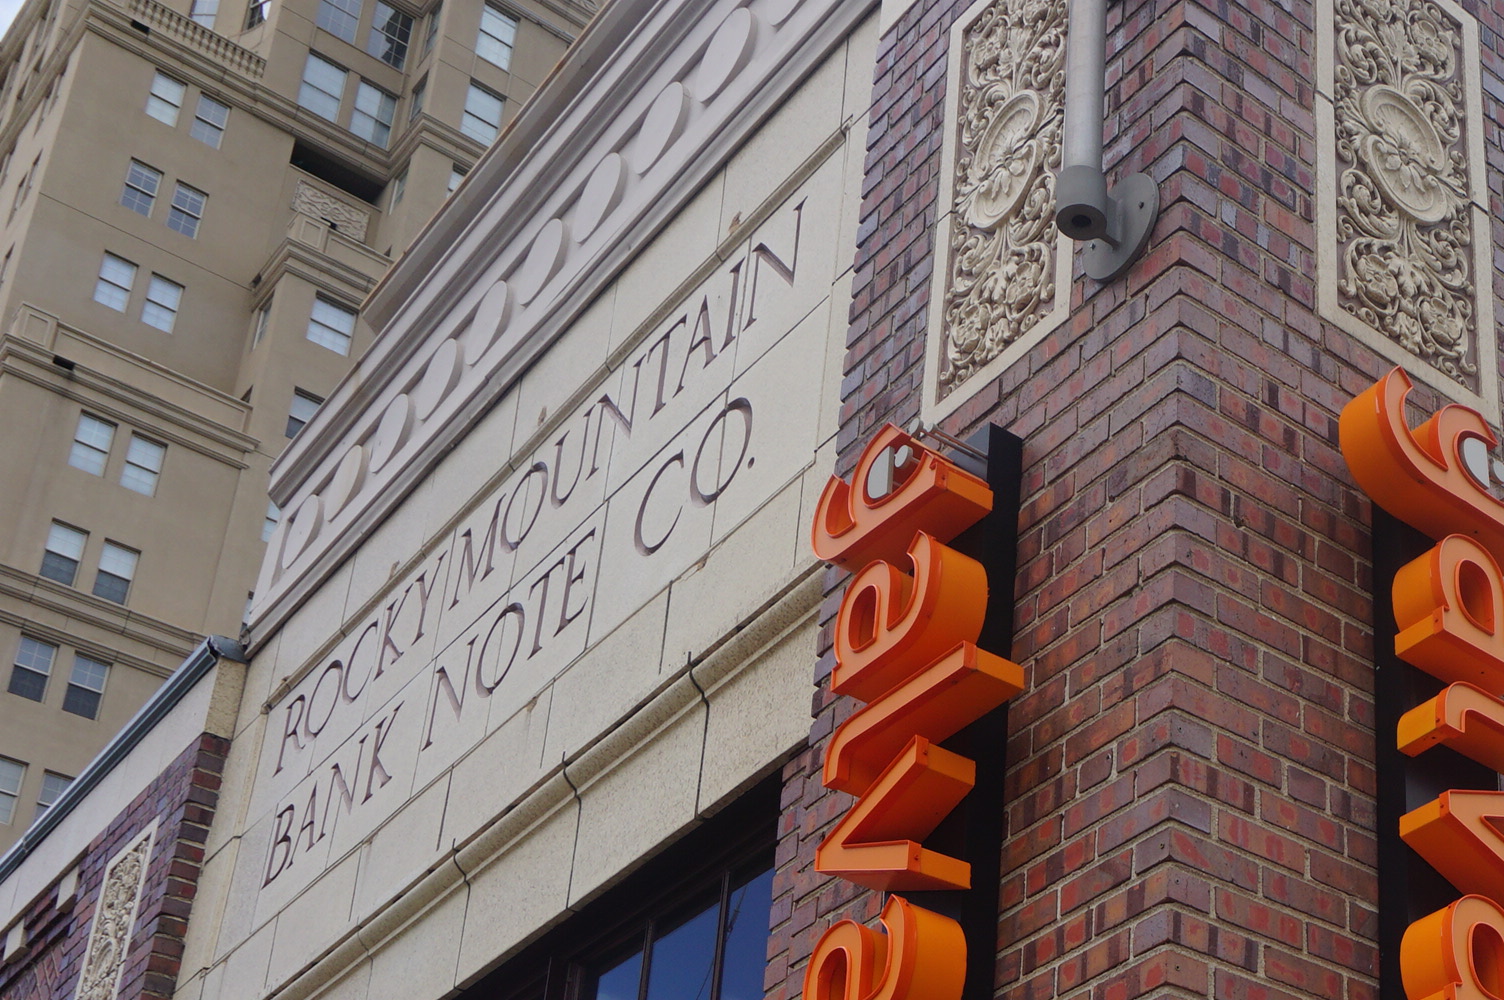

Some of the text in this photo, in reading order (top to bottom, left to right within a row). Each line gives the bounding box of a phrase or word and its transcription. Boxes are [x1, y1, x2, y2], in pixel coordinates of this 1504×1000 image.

[260, 396, 756, 890] BANK NOTE CO.
[272, 195, 809, 778] ROCKY MOUNTAIN
